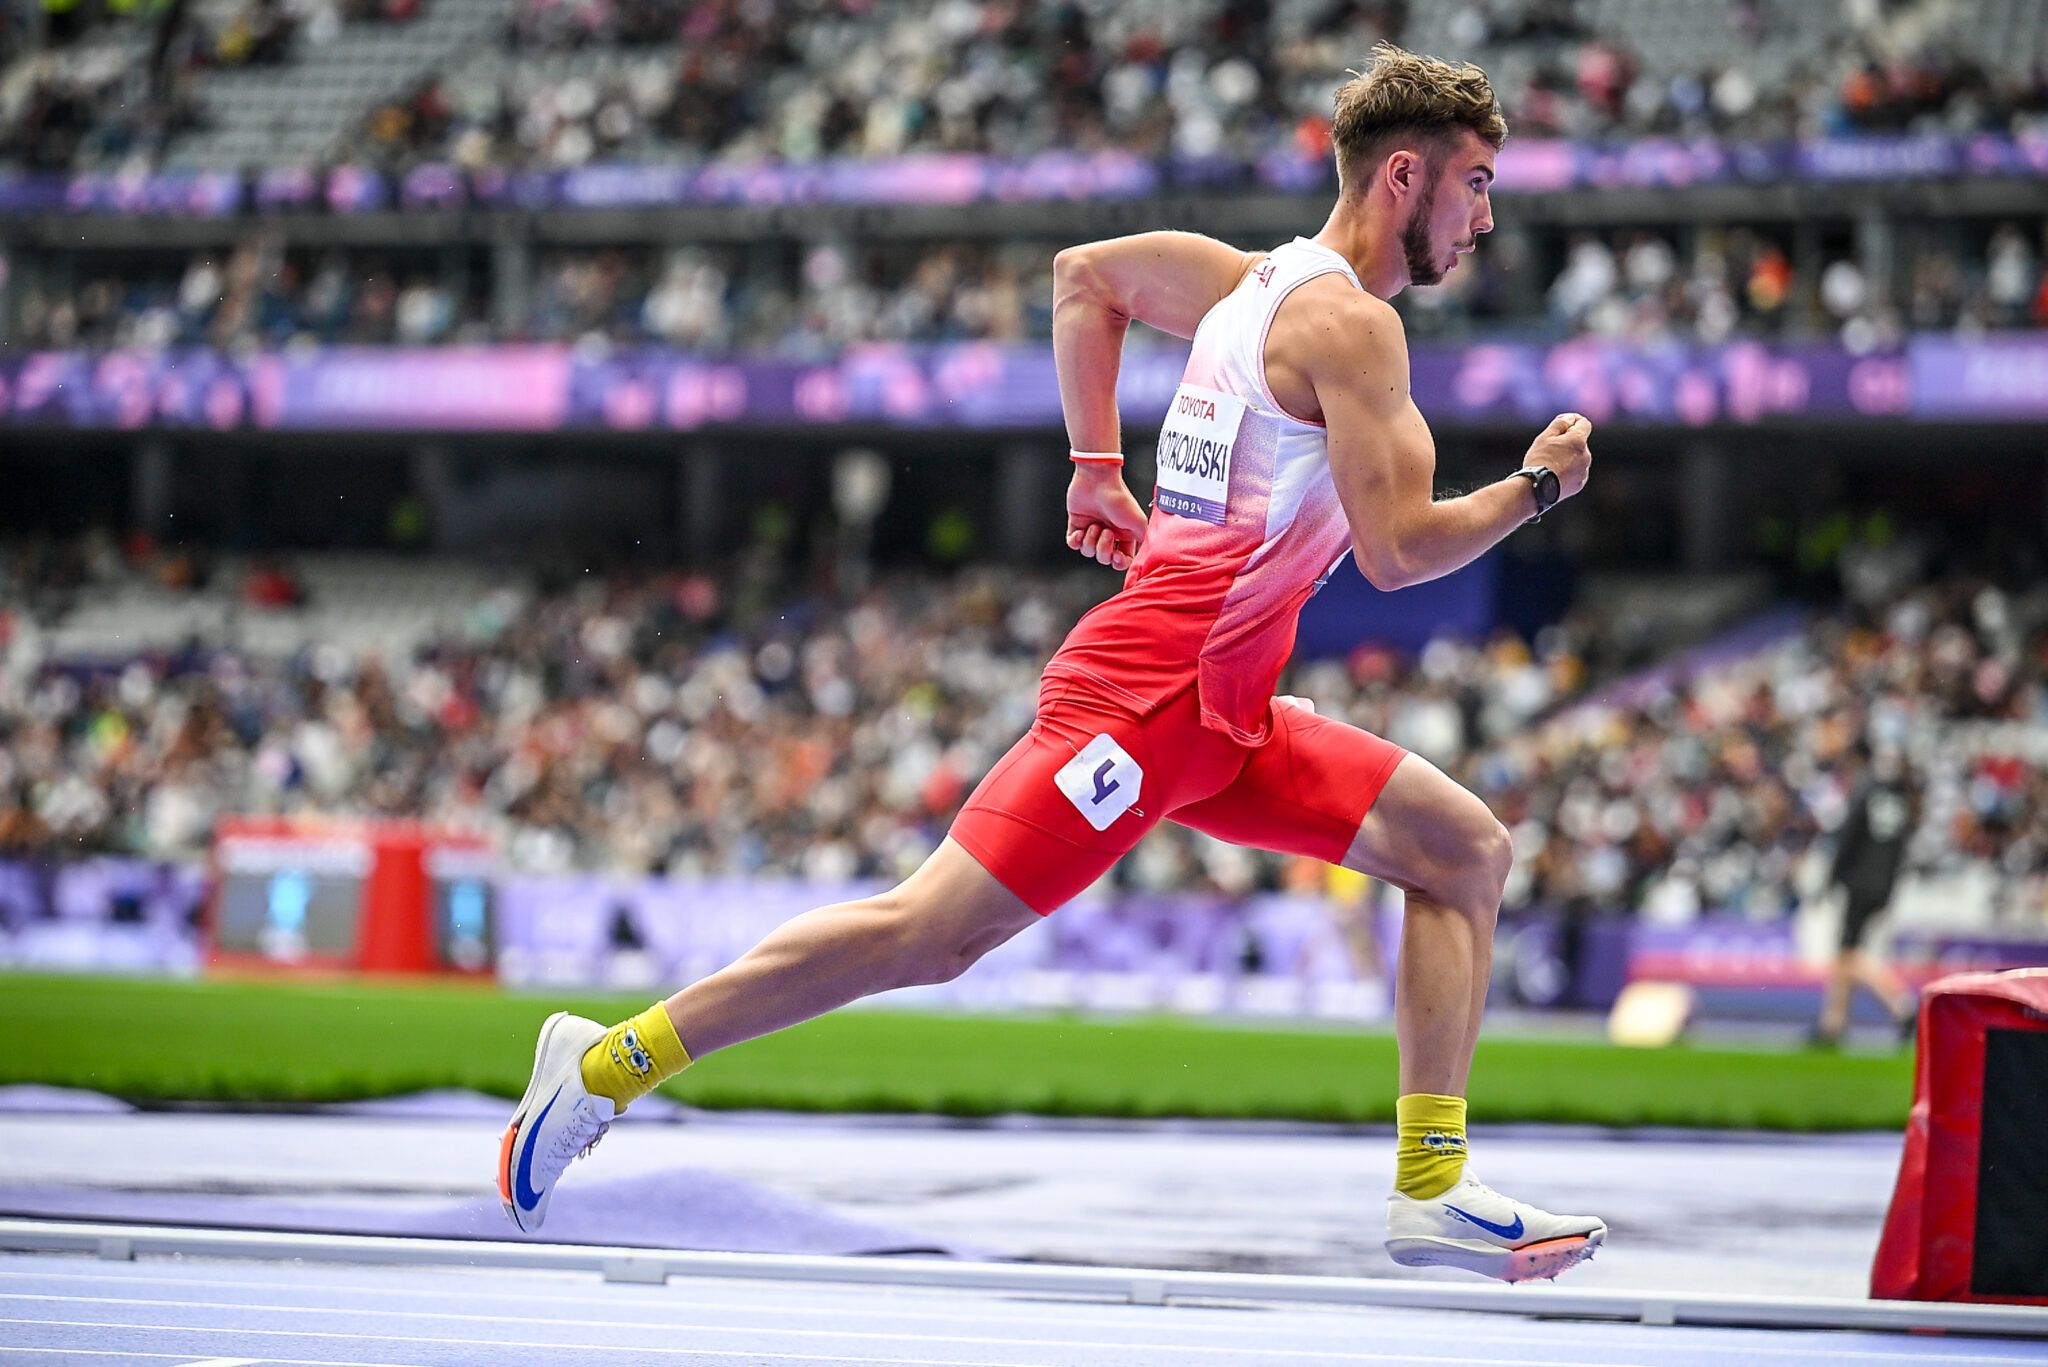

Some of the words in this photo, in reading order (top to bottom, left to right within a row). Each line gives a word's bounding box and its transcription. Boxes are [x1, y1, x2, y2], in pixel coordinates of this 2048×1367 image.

[1177, 395, 1215, 422] TOYOTA
[1177, 499, 1203, 515] 2024
[1091, 758, 1120, 806] 4
